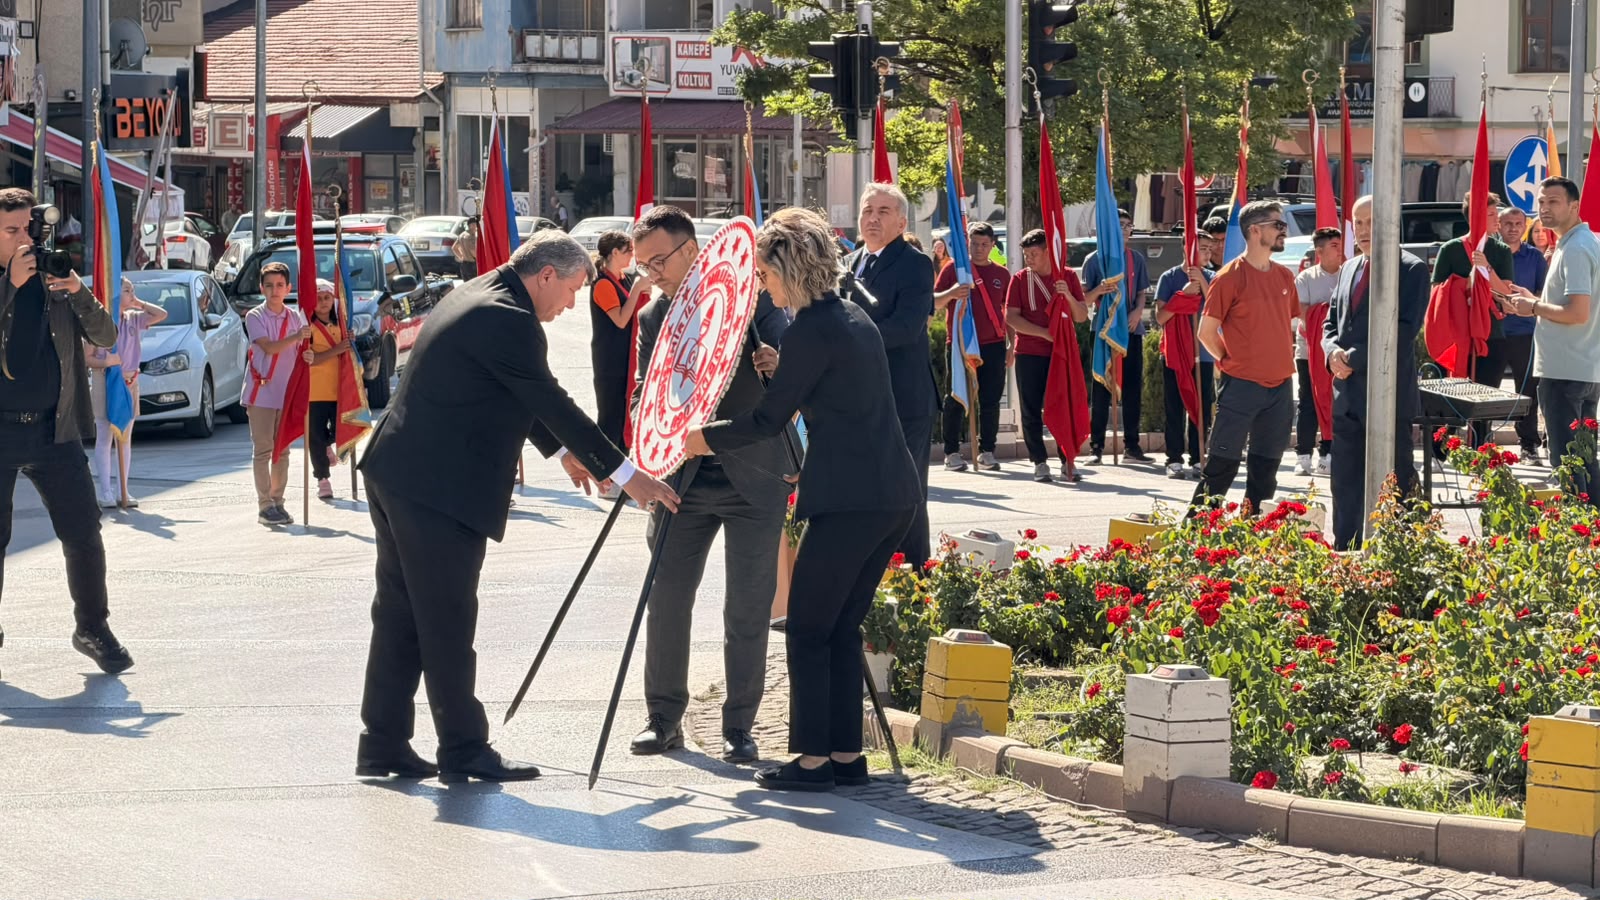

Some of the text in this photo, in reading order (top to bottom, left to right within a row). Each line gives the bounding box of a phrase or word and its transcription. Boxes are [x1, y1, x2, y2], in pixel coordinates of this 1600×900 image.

[677, 43, 710, 57] KANEPE
[678, 74, 710, 87] KOLTUK
[219, 120, 238, 144] E
